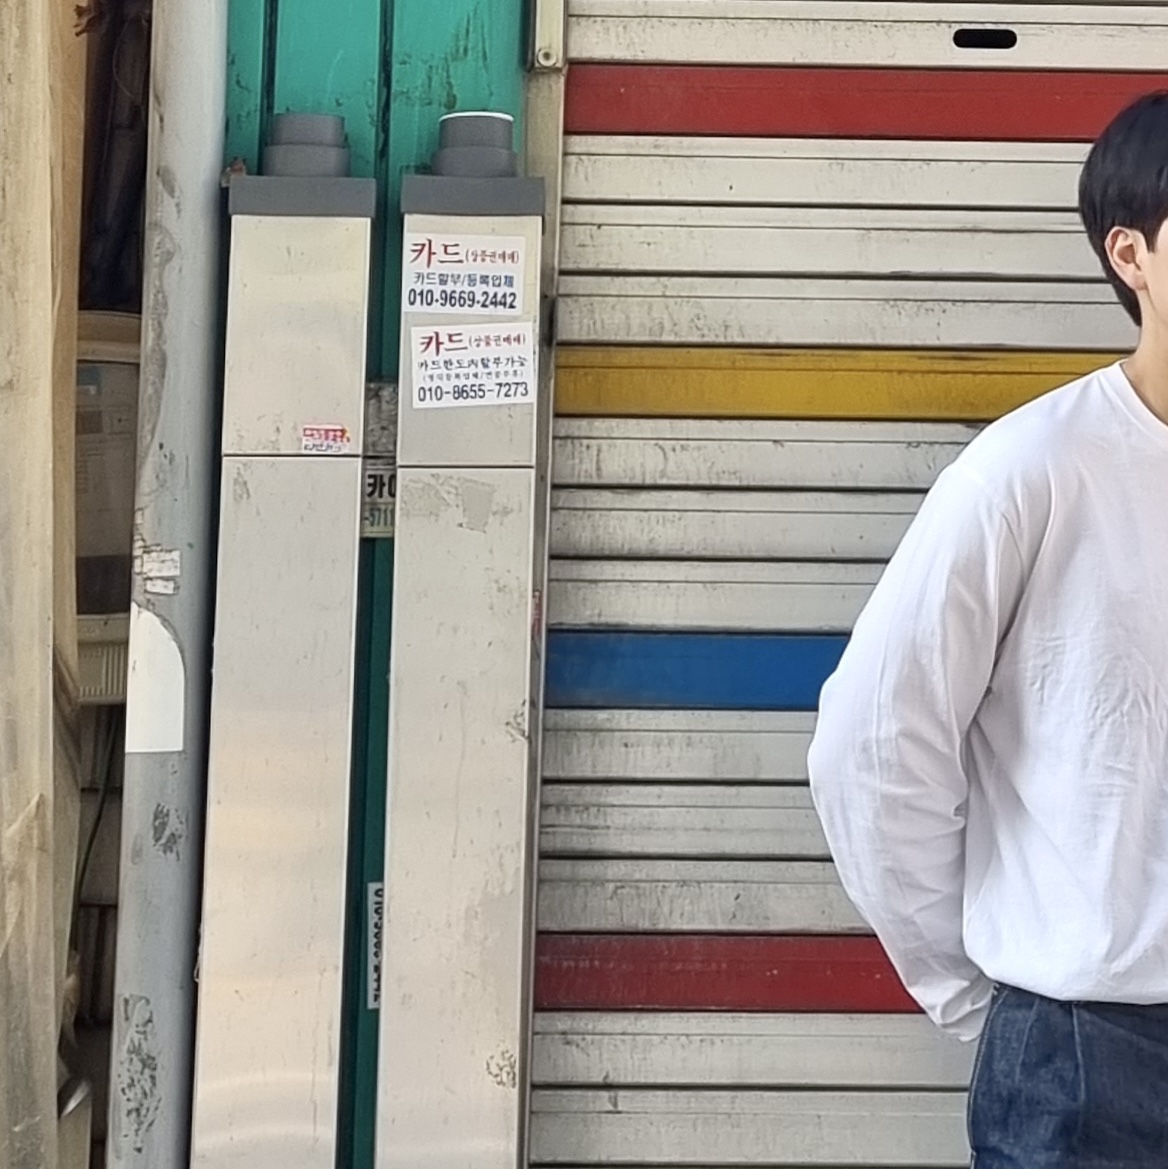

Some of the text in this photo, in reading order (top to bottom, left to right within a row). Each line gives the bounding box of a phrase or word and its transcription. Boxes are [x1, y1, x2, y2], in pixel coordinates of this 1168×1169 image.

[409, 238, 464, 268] 카드
[419, 331, 468, 357] 카드
[418, 382, 529, 402] 010-8655-7273
